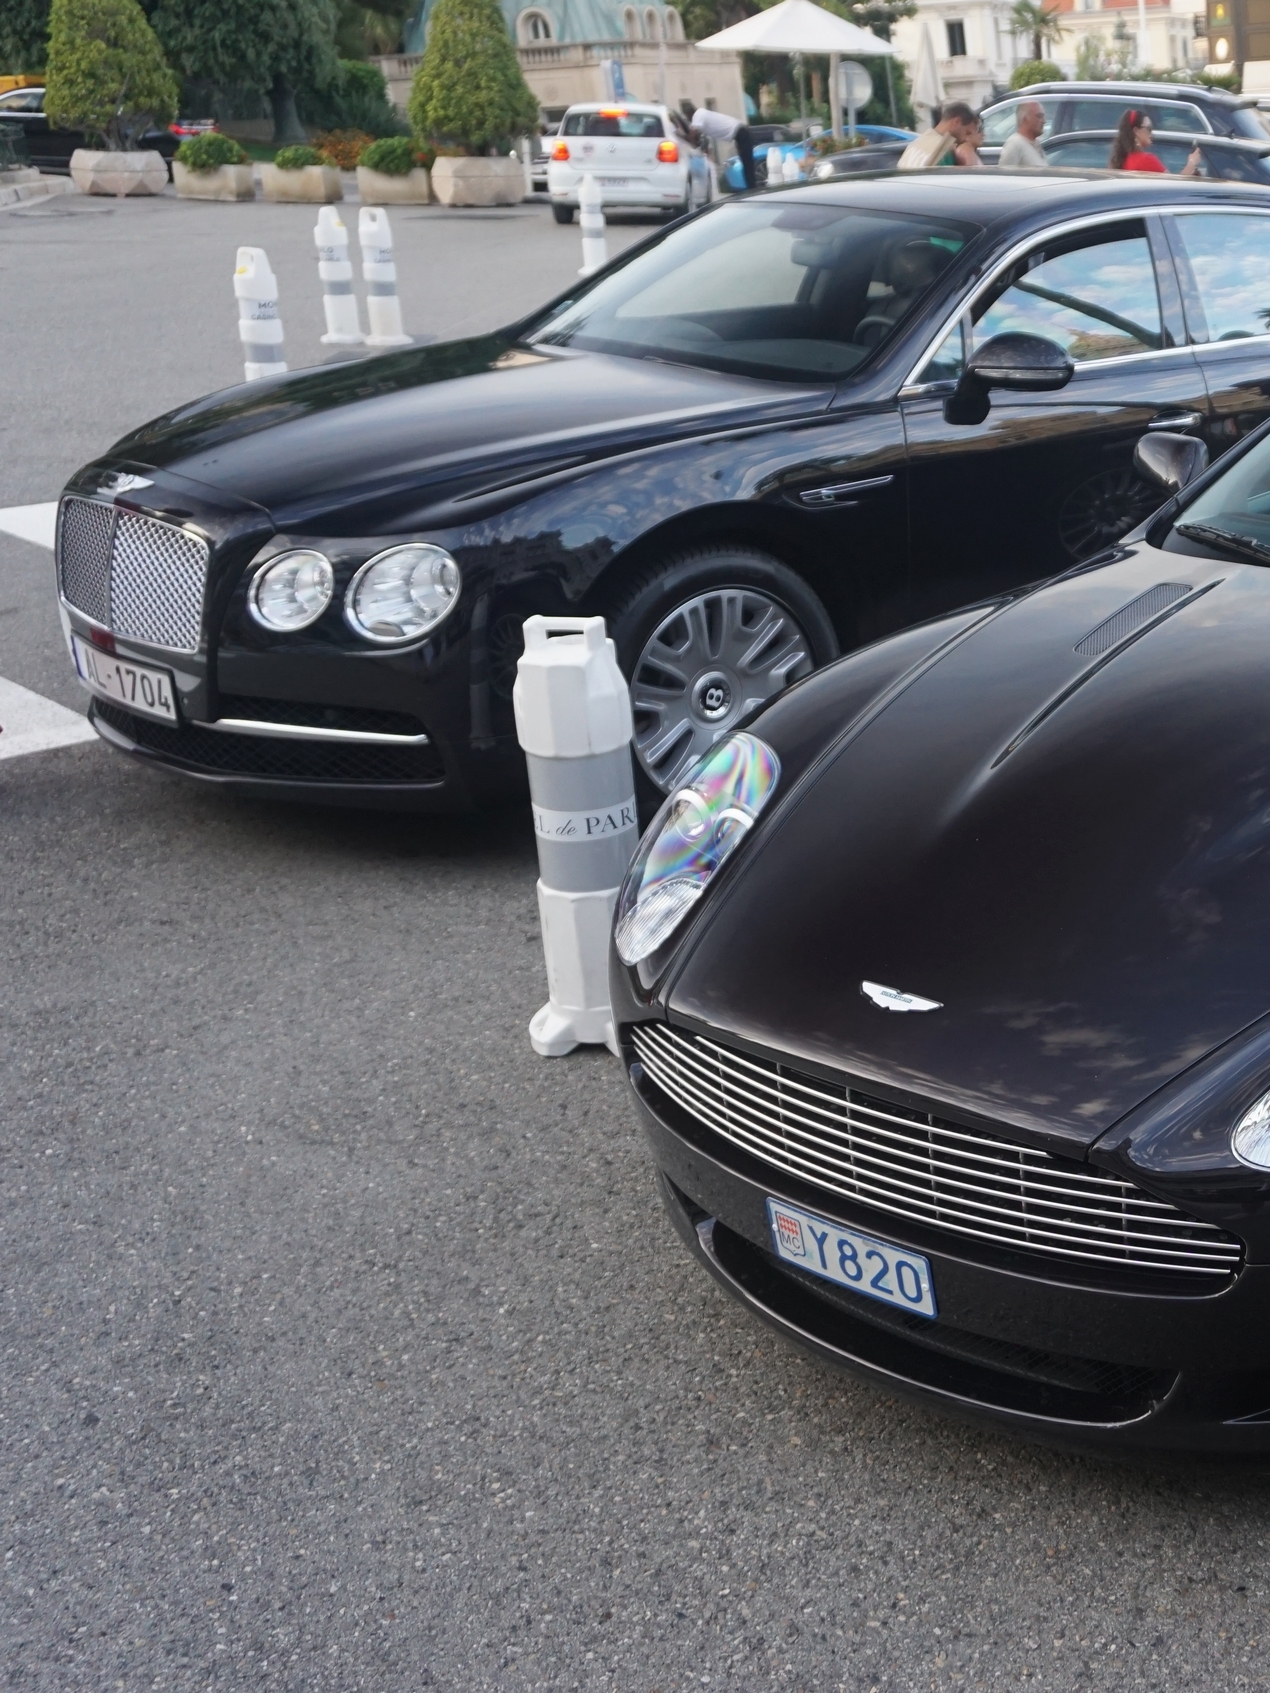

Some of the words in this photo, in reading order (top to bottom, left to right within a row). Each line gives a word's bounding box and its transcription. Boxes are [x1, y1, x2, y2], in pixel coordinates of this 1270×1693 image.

[556, 819, 577, 836] de
[782, 1232, 801, 1249] MC
[807, 1224, 923, 1303] Y820
